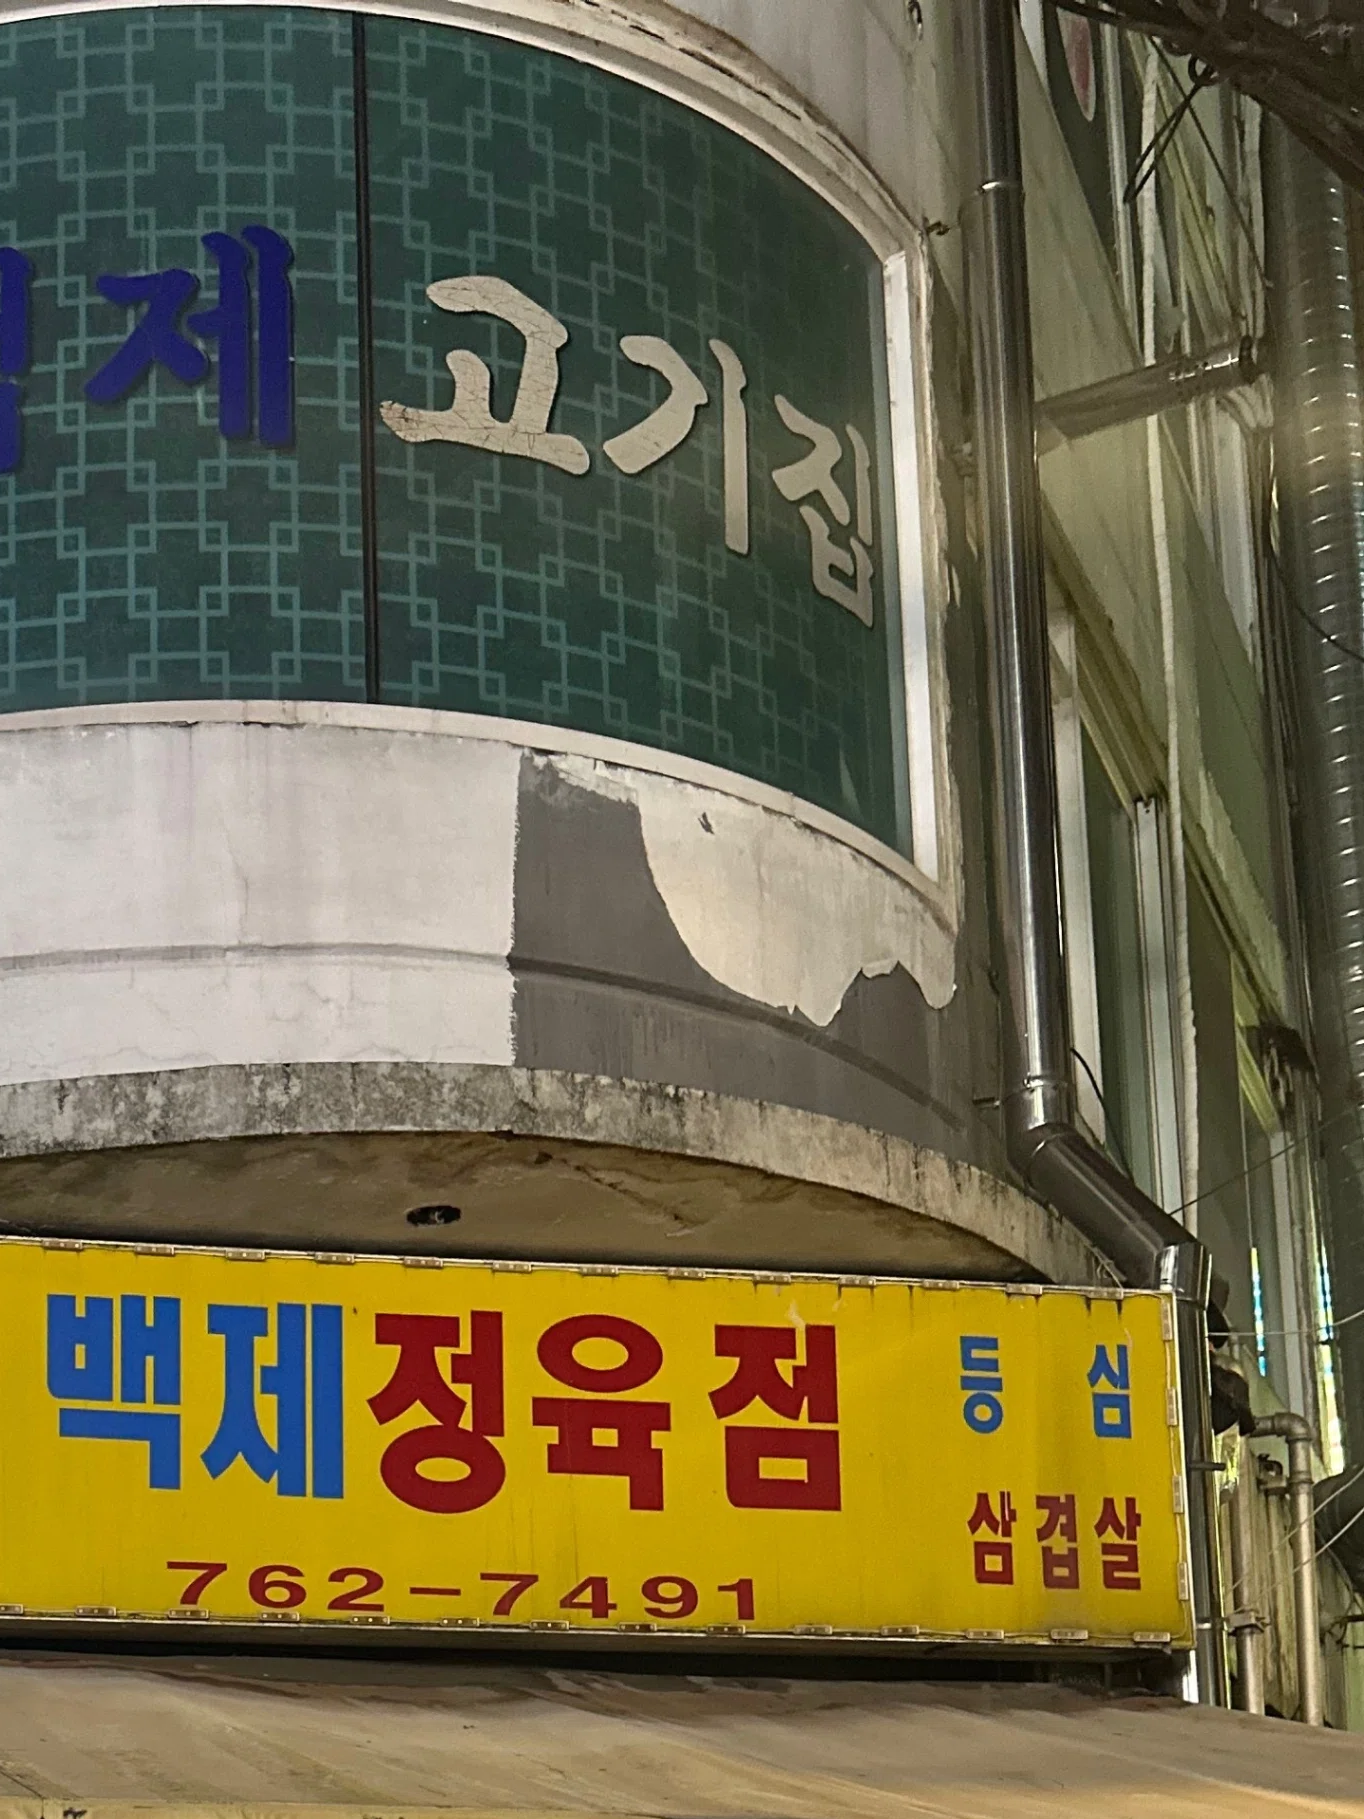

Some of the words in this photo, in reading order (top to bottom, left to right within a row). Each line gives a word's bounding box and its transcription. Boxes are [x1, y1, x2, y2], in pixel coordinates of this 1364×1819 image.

[379, 274, 876, 628] 고기집
[967, 1490, 1142, 1590] 삼겹살
[167, 1561, 756, 1621] 762-7491
